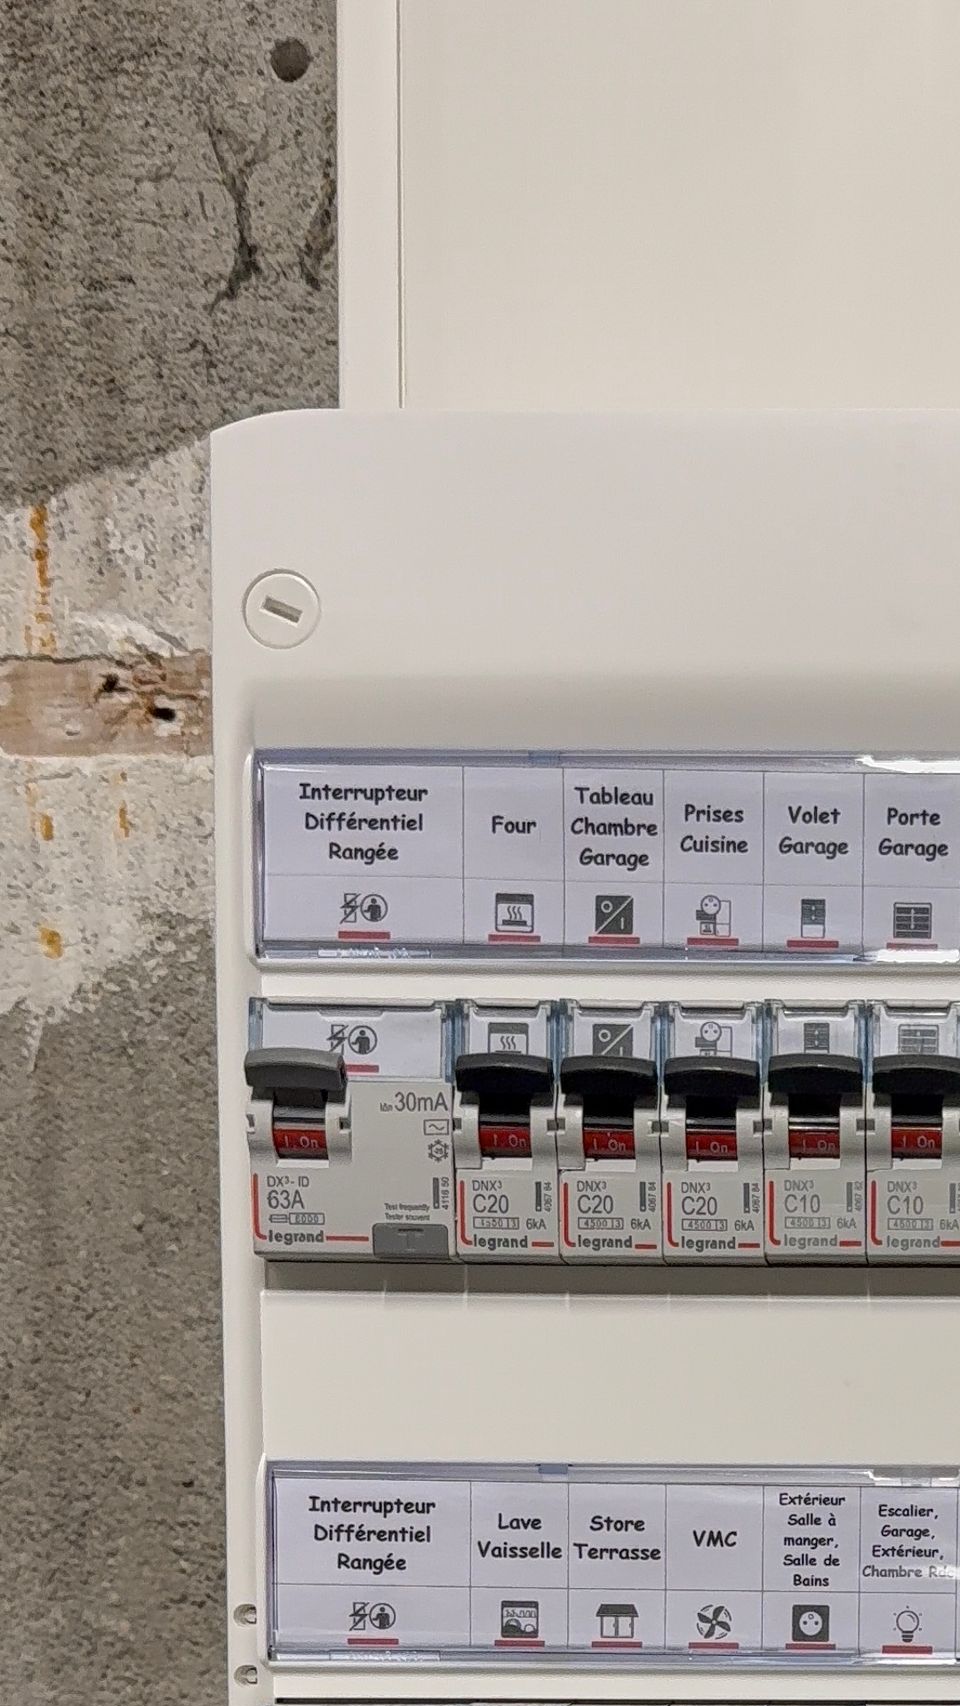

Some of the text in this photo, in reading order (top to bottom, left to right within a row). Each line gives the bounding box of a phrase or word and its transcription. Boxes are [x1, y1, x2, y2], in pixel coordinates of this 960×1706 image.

[299, 783, 428, 805] Interrupteur
[575, 788, 653, 806] Tableau
[684, 804, 744, 823] Prises
[789, 806, 840, 825] Volet
[887, 808, 941, 826] Porte
[305, 813, 423, 832] Différentiel
[492, 817, 536, 834] Four
[571, 818, 657, 836] Chambre
[680, 836, 748, 853] Cuisine
[779, 838, 848, 859] Garage
[879, 839, 948, 860] Garage
[329, 844, 398, 864] Rangée
[580, 849, 649, 870] Garage
[395, 1092, 448, 1112] 30mA
[268, 1190, 305, 1209] 63A
[473, 1194, 509, 1213] C20
[578, 1195, 613, 1214] C20
[682, 1196, 717, 1215] C20
[784, 1195, 820, 1213] C10
[888, 1196, 923, 1214] C10
[526, 1219, 547, 1230] 6kA
[631, 1219, 650, 1230] 6kA
[735, 1220, 754, 1231] 6kA
[837, 1218, 856, 1228] 6kA
[269, 1231, 324, 1243] legrand
[474, 1234, 528, 1250] legrand
[578, 1235, 632, 1250] legrand
[681, 1236, 736, 1250] legrand
[784, 1234, 837, 1249] legrand
[887, 1236, 940, 1250] legrand
[309, 1496, 435, 1517] Interrupteur
[779, 1493, 845, 1506] Extérieur
[788, 1514, 836, 1526] Salle à
[879, 1505, 938, 1519] Escalier,
[498, 1513, 541, 1530] Lave
[590, 1516, 645, 1532] Store
[315, 1524, 430, 1543] Différentiel
[693, 1530, 737, 1547] VMC
[881, 1526, 935, 1540] Garage,
[478, 1542, 562, 1560] Vaisselle
[573, 1543, 661, 1560] Terrasse
[784, 1537, 839, 1549] manger,
[784, 1555, 840, 1567] Salle de
[872, 1546, 944, 1560] Extérieur,
[338, 1554, 406, 1574] Rangée
[862, 1565, 922, 1578] Chambre
[794, 1575, 829, 1587] Bains
